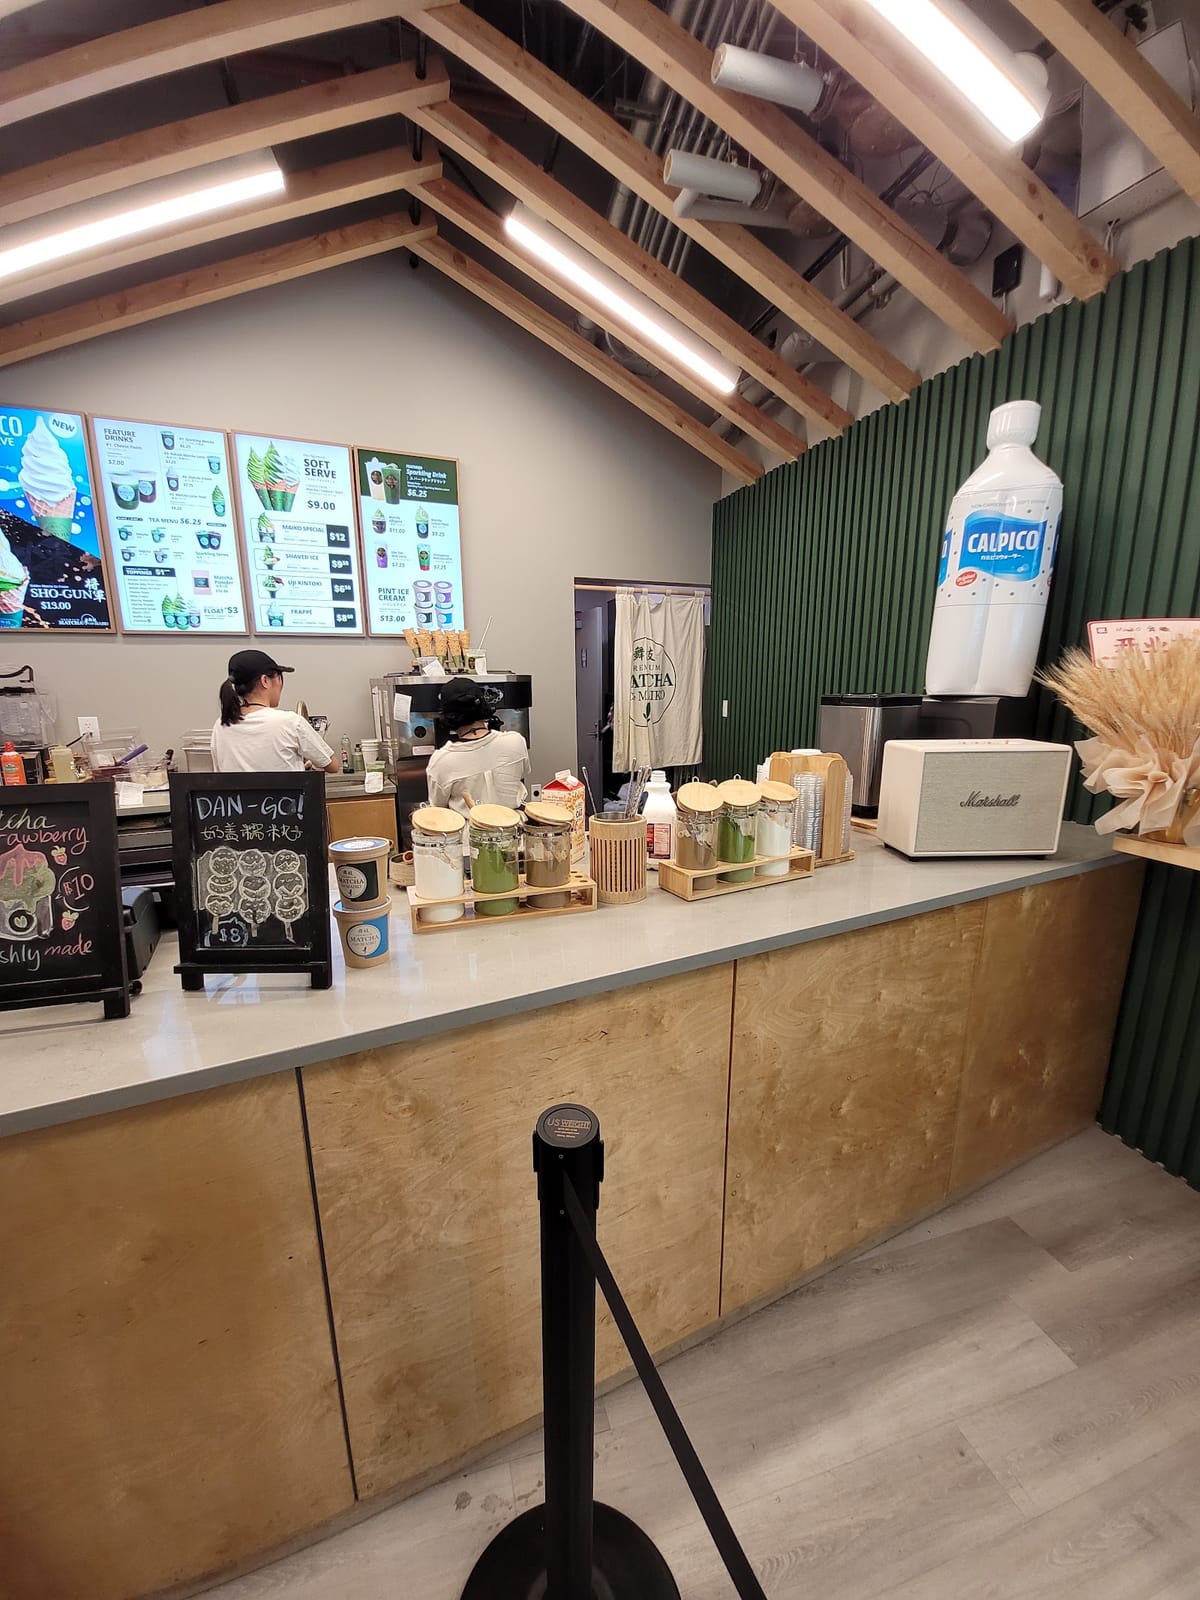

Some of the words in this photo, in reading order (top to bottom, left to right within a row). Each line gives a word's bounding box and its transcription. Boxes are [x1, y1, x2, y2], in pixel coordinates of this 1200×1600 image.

[52, 418, 75, 432] NEW
[103, 428, 137, 438] FEATURE
[104, 433, 134, 444] DRINKS
[303, 458, 331, 469] SOFT
[304, 468, 337, 479] SERVE
[307, 500, 336, 511] $9.00
[180, 517, 202, 526] $6.25
[329, 532, 346, 542] $12
[967, 530, 1039, 553] CALPICO
[30, 588, 92, 600] SHO-GUN
[377, 587, 397, 595] PINT
[378, 594, 406, 602] CREAM
[41, 602, 72, 610] $13.00
[959, 790, 1021, 808] Marshall
[218, 927, 242, 943] $8
[44, 932, 93, 956] made
